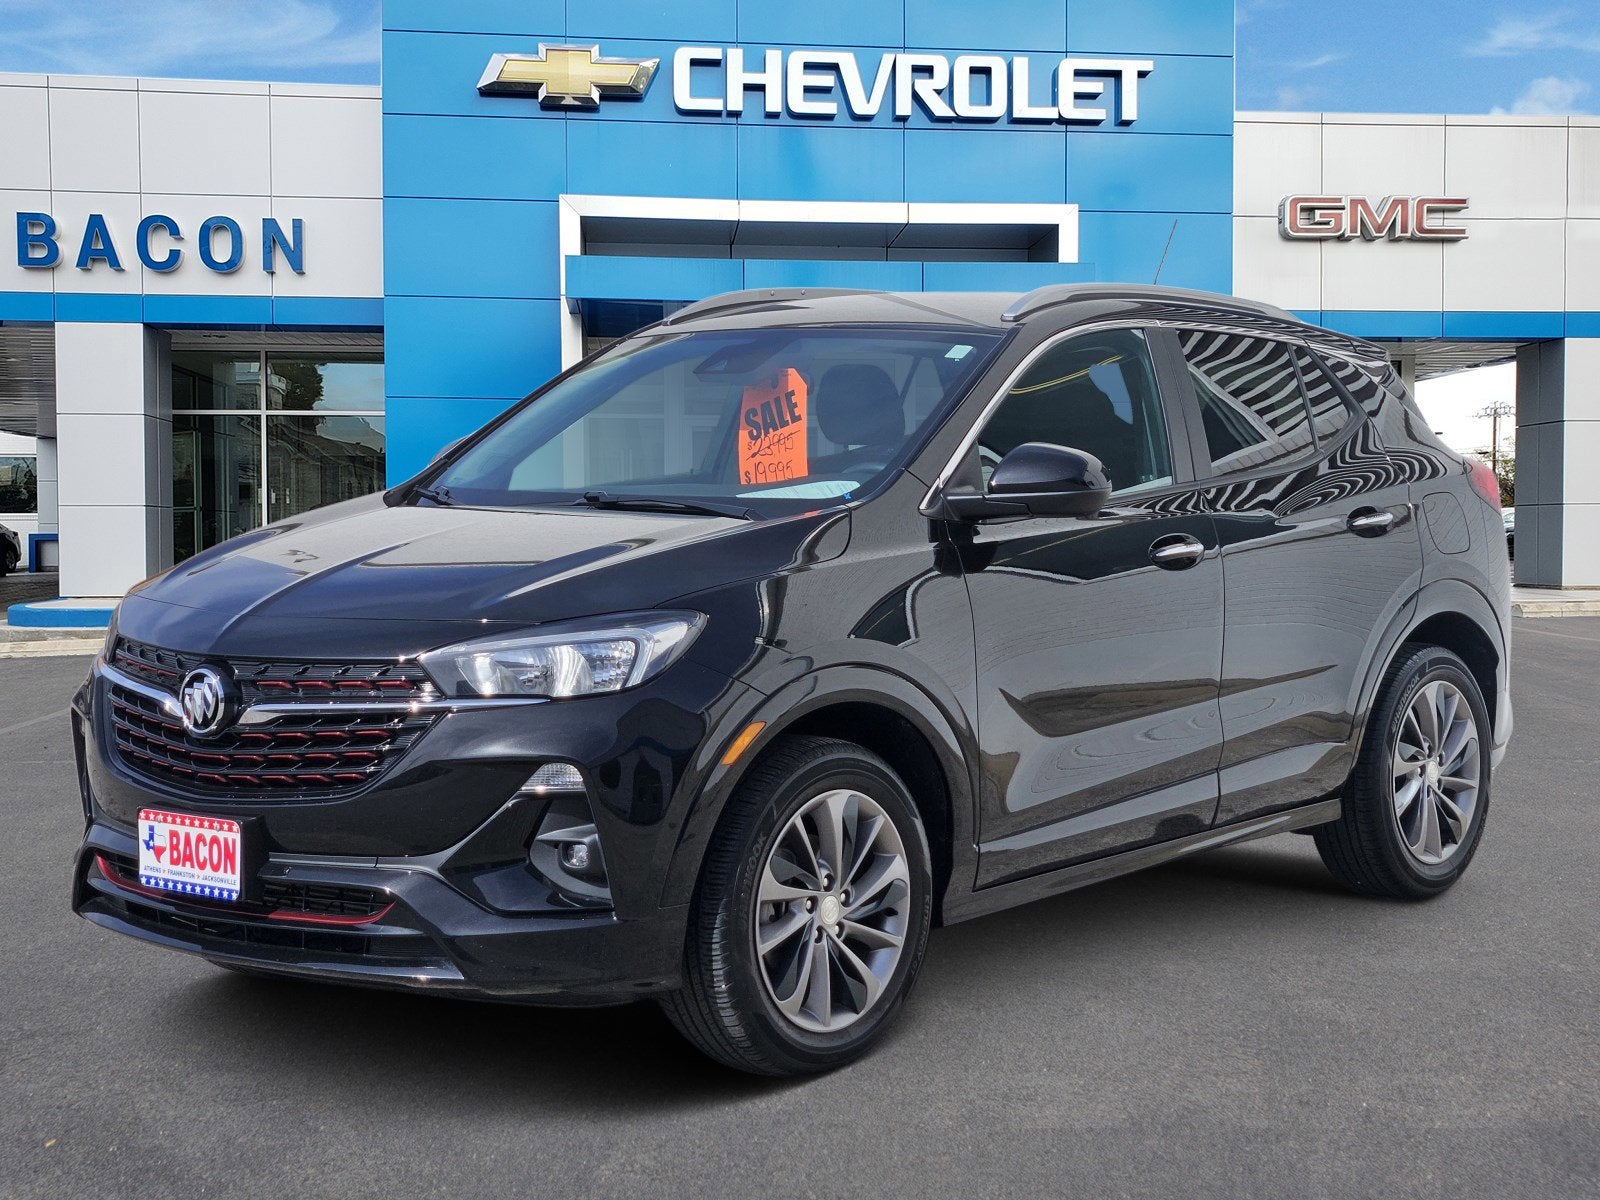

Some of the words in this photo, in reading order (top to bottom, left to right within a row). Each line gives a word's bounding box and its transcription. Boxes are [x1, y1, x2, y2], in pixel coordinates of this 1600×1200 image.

[672, 46, 1154, 126] CHEVROLET
[1278, 194, 1469, 241] GMC
[16, 211, 306, 275] BACON
[744, 389, 803, 441] SALE
[144, 865, 162, 874] ATHENS
[167, 869, 196, 879] FRANKSTON
[202, 874, 237, 886] JACKSONVILLE
[169, 829, 237, 875] BACON
